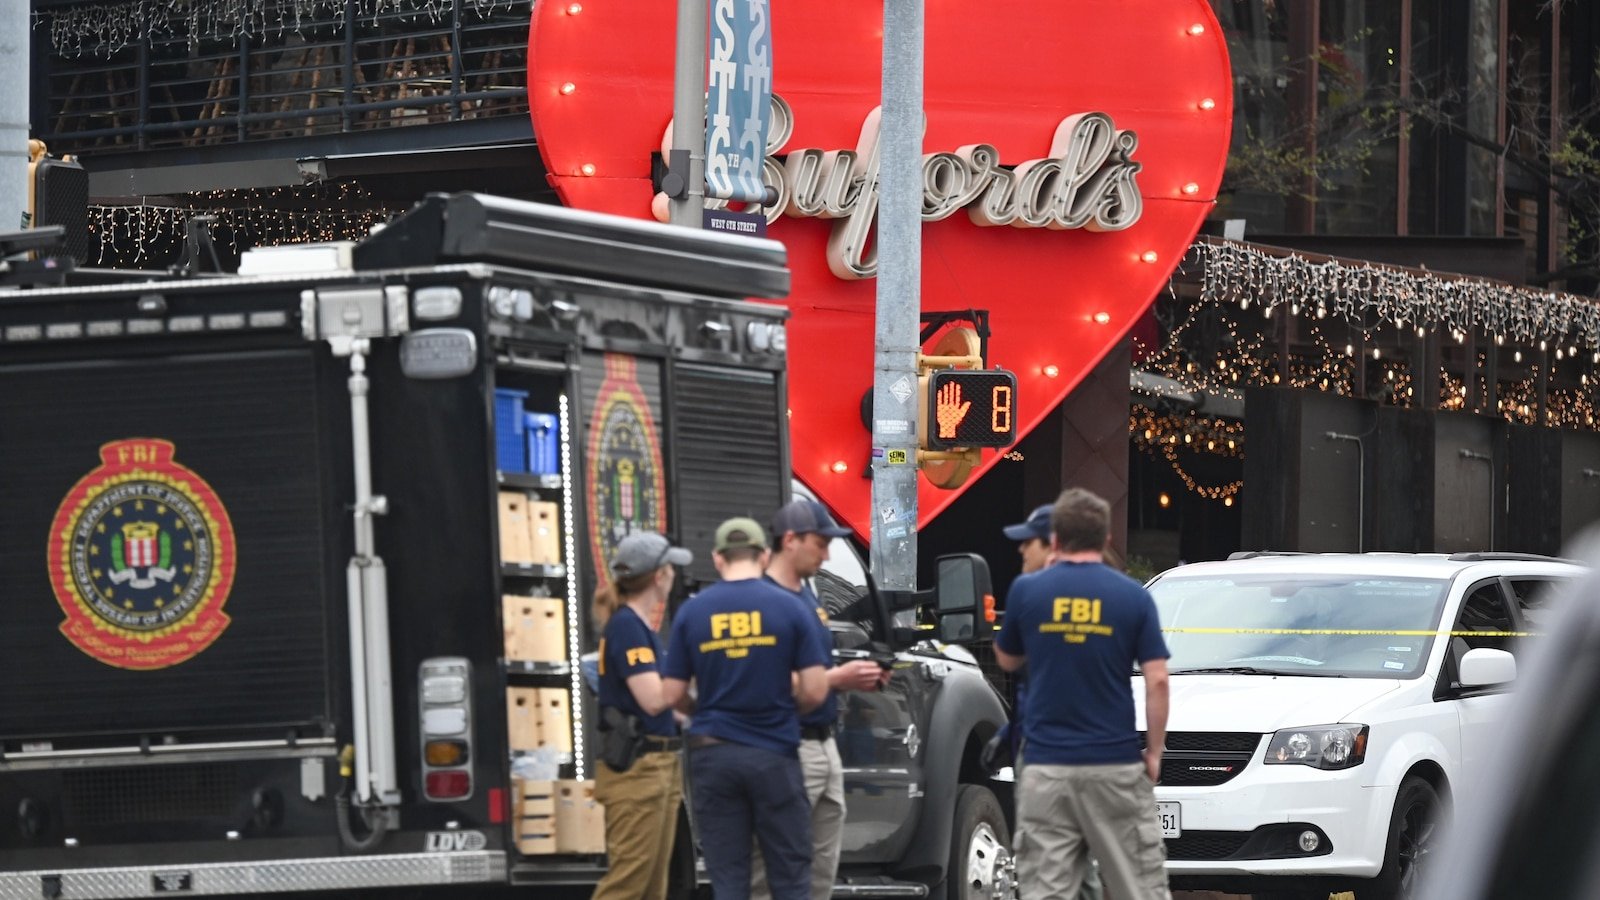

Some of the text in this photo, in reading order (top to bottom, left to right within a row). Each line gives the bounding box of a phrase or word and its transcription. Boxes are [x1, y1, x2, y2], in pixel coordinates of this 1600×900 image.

[711, 218, 757, 232] WEST 6TH STREET
[992, 386, 1011, 432] 8
[117, 445, 157, 465] FBI
[79, 485, 202, 538] DEPARTMENT OF JUSTICE
[142, 614, 159, 626] OF
[1053, 597, 1101, 623] FBI
[711, 611, 761, 639] FBI
[1156, 814, 1176, 830] 51
